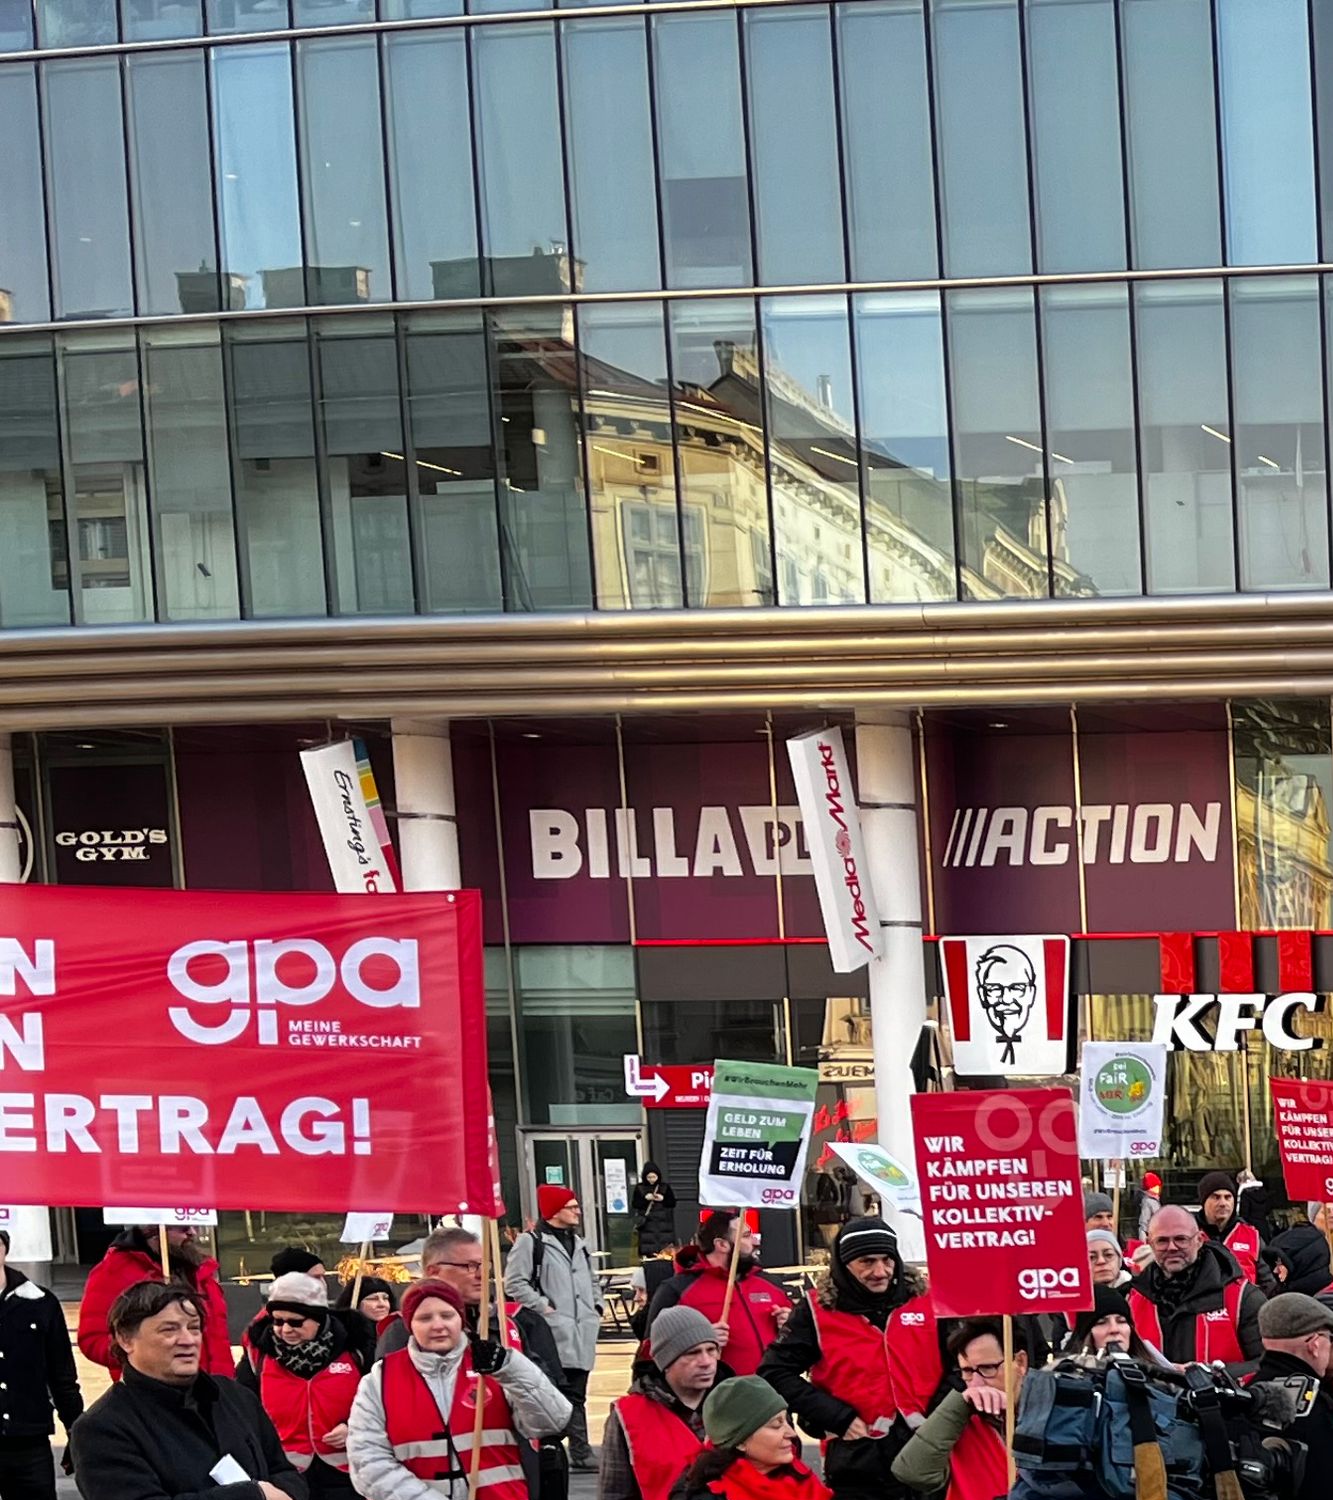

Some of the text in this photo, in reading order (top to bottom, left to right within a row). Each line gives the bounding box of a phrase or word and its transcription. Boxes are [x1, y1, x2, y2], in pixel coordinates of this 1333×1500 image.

[333, 769, 370, 866] Ernsting's
[55, 828, 168, 846] GOLD'S
[529, 806, 743, 879] BILLA
[980, 801, 1222, 867] ACTION
[816, 741, 875, 954] Media Markt
[167, 936, 421, 1046] gpa
[289, 1020, 342, 1034] MEINE
[1152, 992, 1319, 1052] KFC
[288, 1034, 422, 1049] GEWERKSCHAFT
[1277, 1097, 1297, 1109] WIR
[724, 1112, 787, 1128] GELD ZUM
[1279, 1110, 1328, 1124] KÄMPFEN
[722, 1126, 762, 1139] LEBEN
[1281, 1124, 1302, 1137] FÜR
[720, 1146, 773, 1162] ZEIT FÜR
[923, 1136, 966, 1154] WIR
[718, 1161, 787, 1176] ERHOLUNG
[926, 1156, 1029, 1178] KÄMPFEN
[761, 1188, 795, 1204] gpa
[929, 1180, 1073, 1202] FÜR UNSEREN
[932, 1205, 1054, 1226] KOLLEKTIV-
[934, 1229, 1037, 1249] VERTRAG!
[1018, 1267, 1081, 1300] gpa
